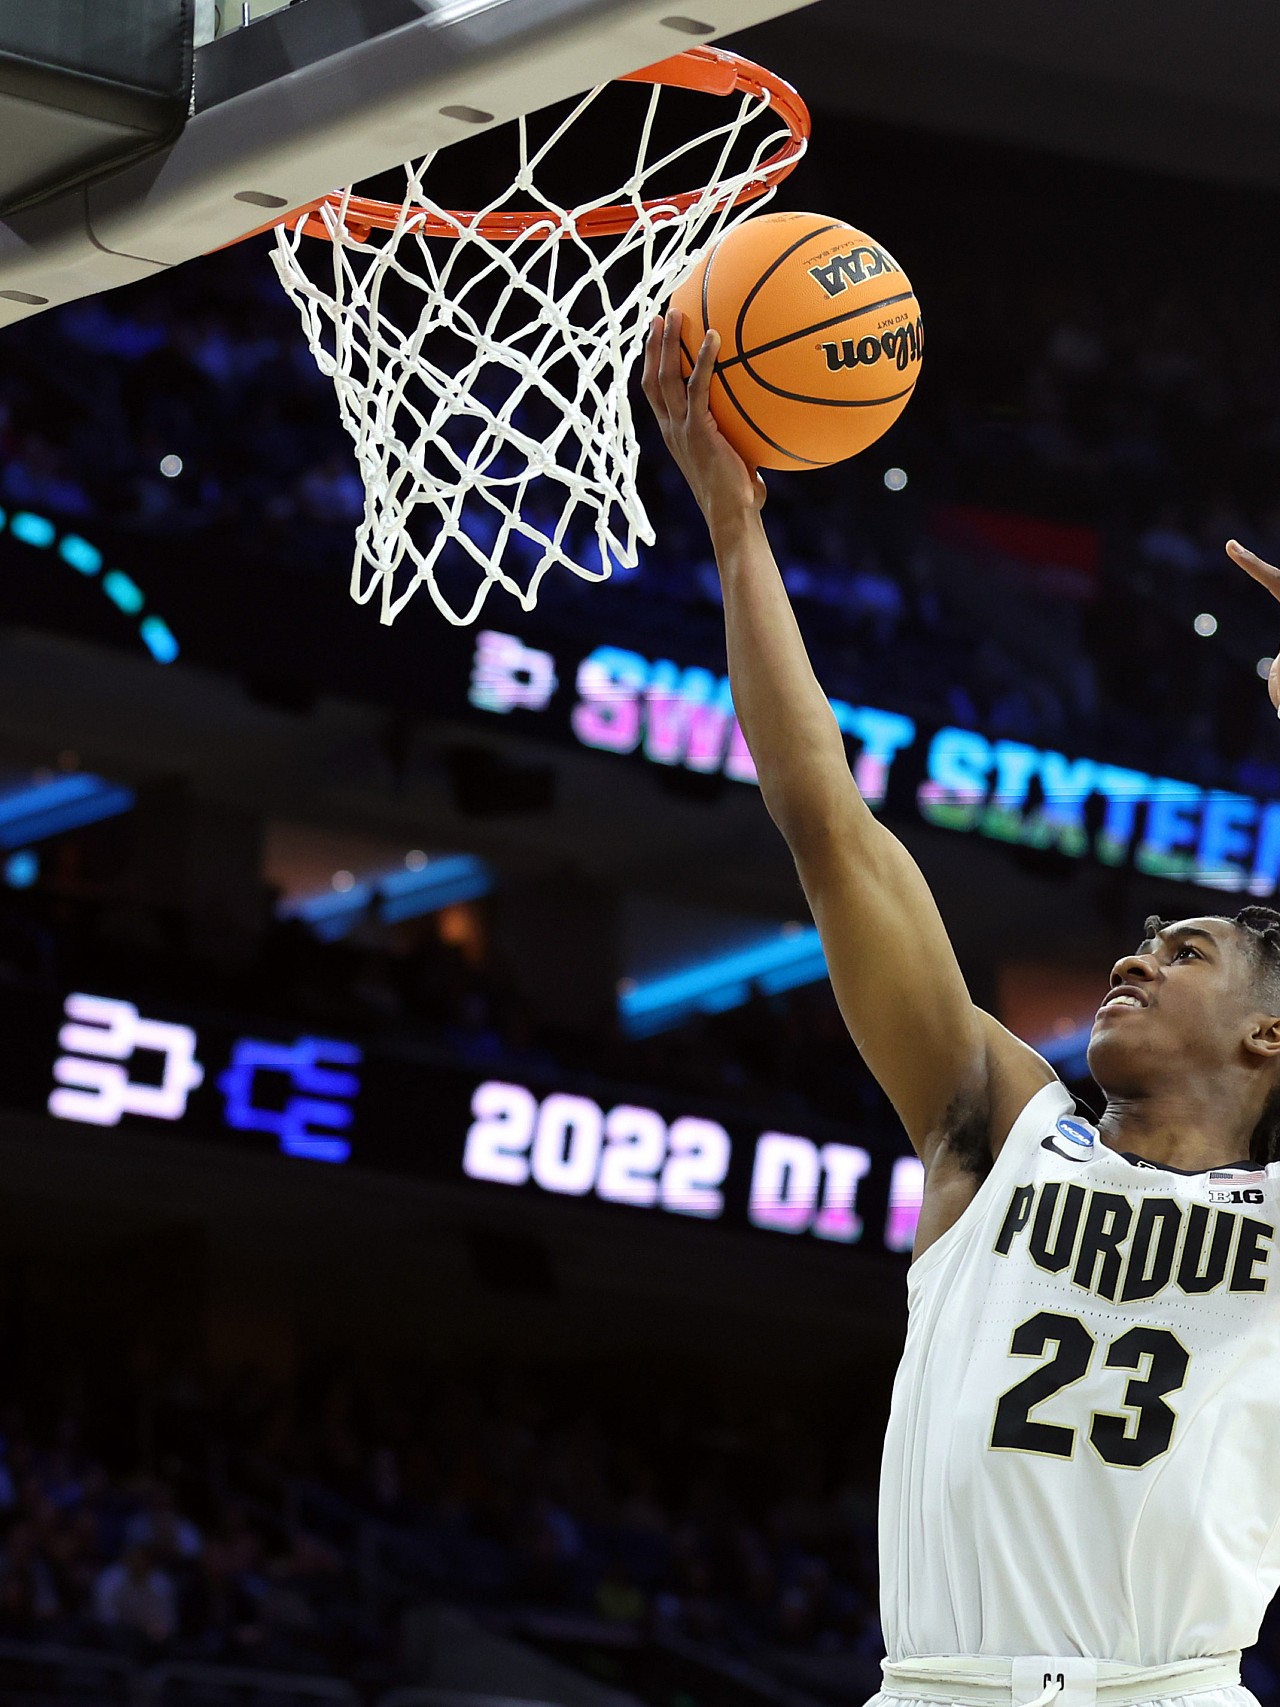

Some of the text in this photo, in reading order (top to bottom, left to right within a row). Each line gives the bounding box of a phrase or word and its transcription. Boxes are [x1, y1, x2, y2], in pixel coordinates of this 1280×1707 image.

[877, 312, 909, 330] EVO NXT
[571, 644, 917, 811] SWT
[462, 1080, 732, 1221] 2022
[747, 1130, 873, 1245] DI
[1060, 1122, 1092, 1146] NCAA
[992, 1180, 1276, 1306] PURDUE
[988, 1310, 1193, 1472] 23
